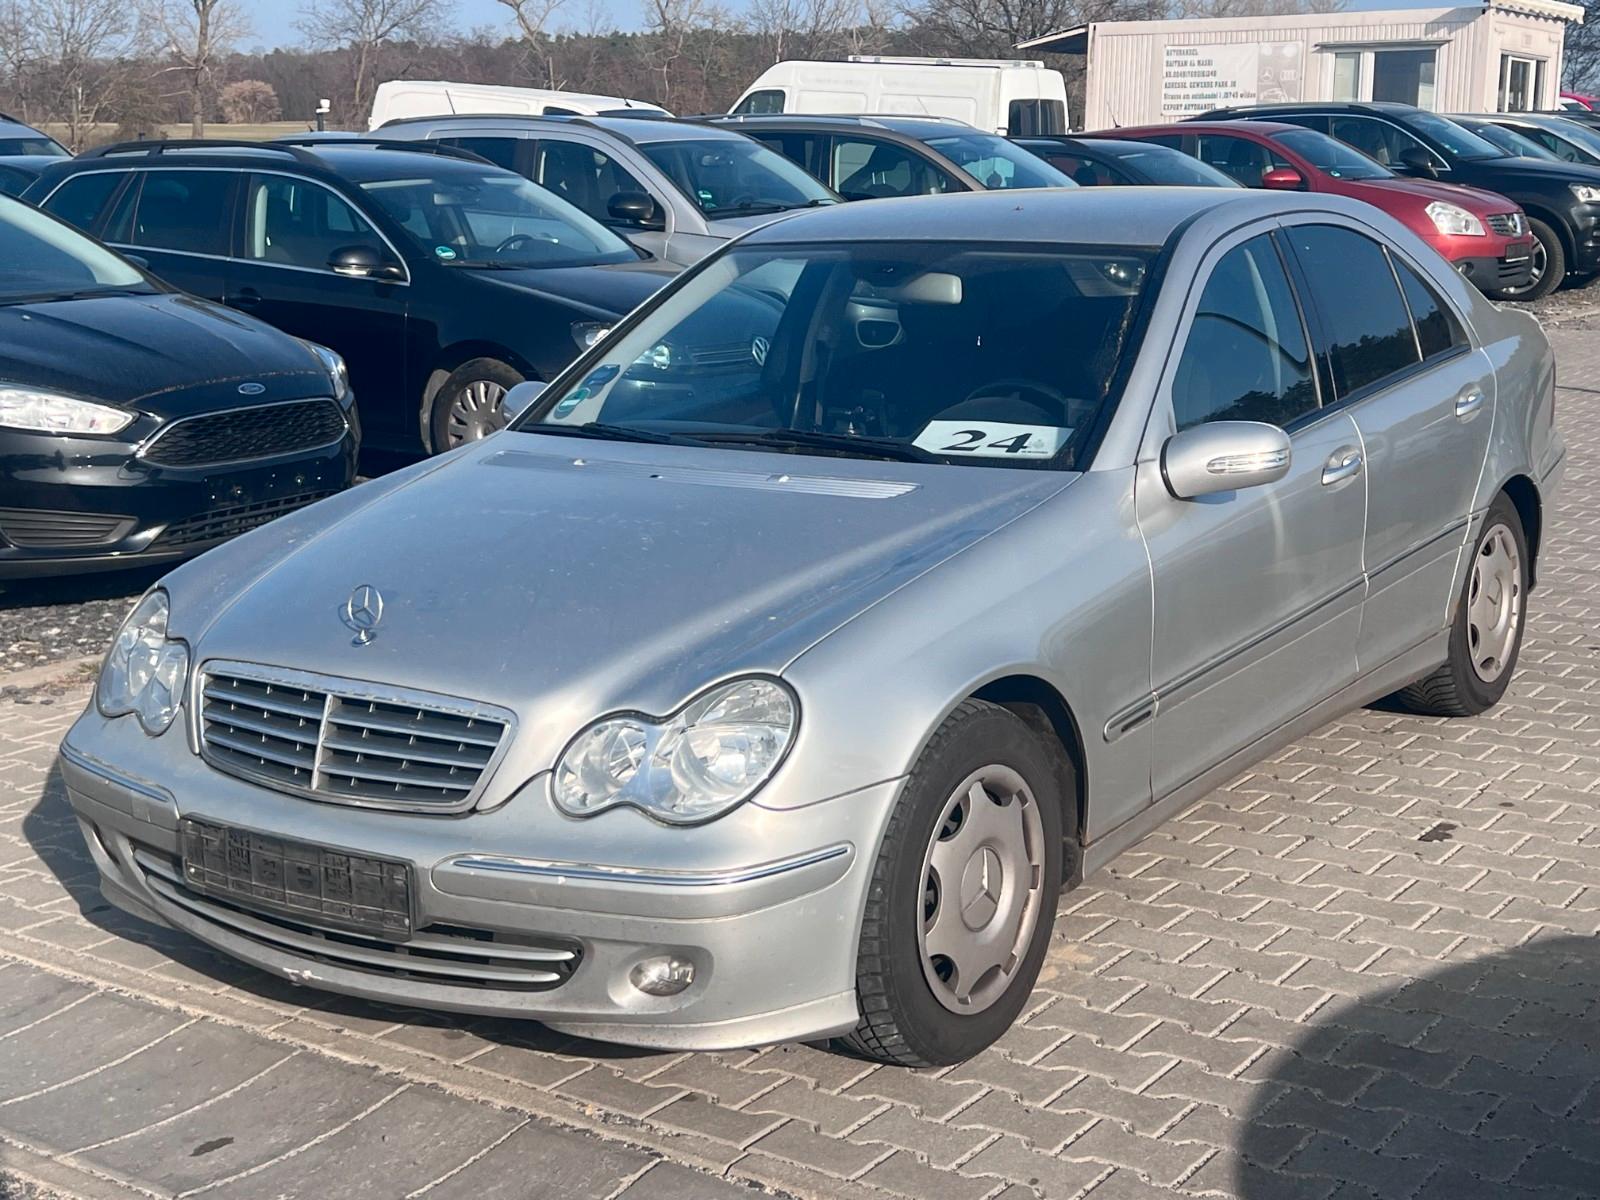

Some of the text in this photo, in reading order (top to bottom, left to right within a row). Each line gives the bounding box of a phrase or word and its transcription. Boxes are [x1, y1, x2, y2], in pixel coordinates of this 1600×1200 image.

[1166, 48, 1199, 56] AUTOHANDEL
[1214, 80, 1228, 88] PARK
[1163, 103, 1217, 111] EXPORT AUTOHANDEL
[939, 429, 1033, 454] 24
